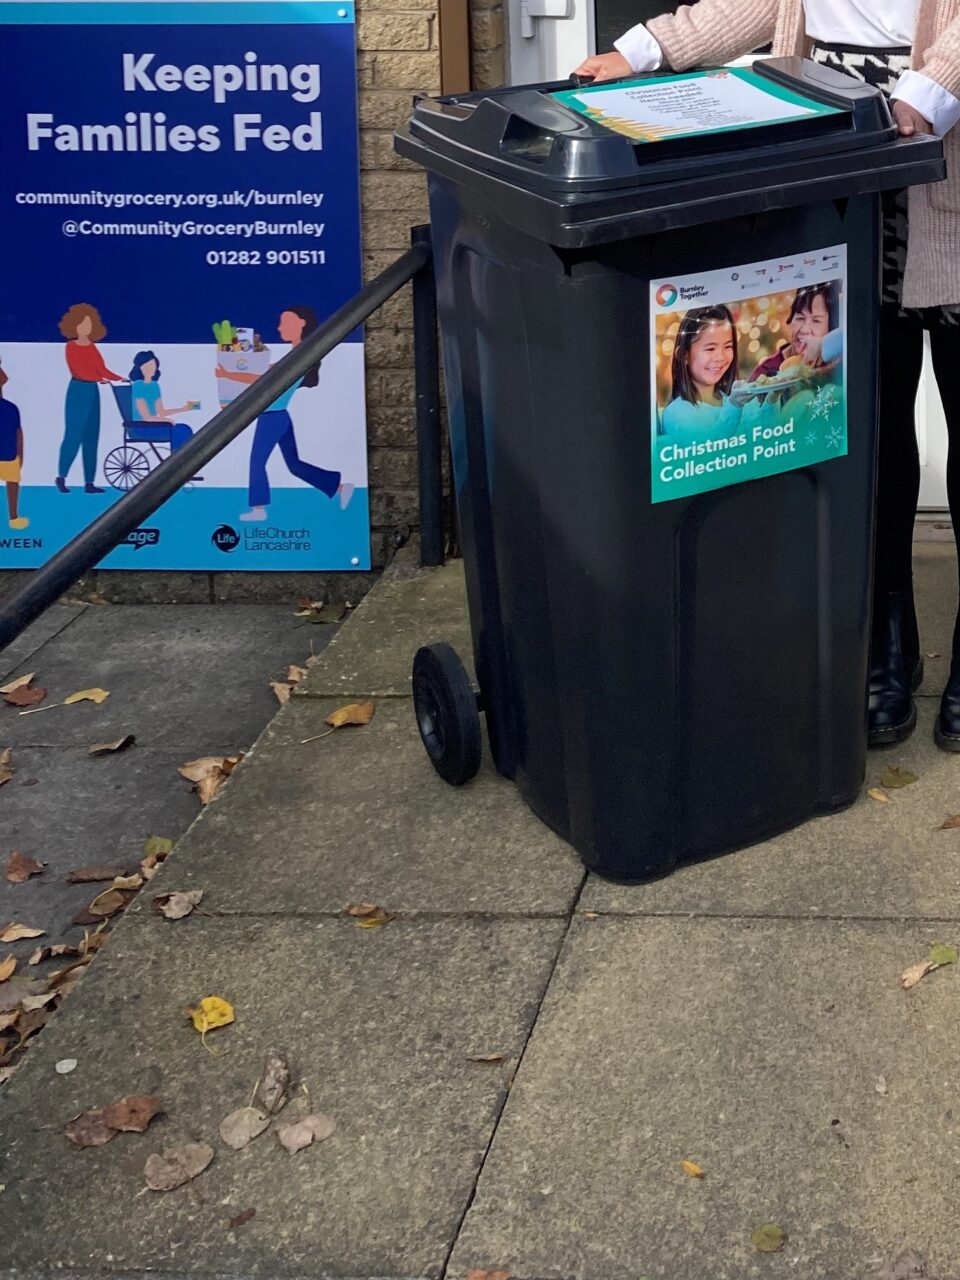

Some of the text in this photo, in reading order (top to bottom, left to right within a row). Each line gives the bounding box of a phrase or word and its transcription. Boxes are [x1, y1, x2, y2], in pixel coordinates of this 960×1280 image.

[122, 53, 320, 103] Keeping
[27, 113, 323, 151] Families Fed
[16, 189, 323, 208] communitygrocery.org.uk/burnley
[62, 221, 324, 238] @CommunityGroceryBurnley
[207, 250, 325, 265] 01282 901511
[680, 285, 704, 293] Burnley
[680, 291, 708, 300] Together
[660, 418, 794, 462] Christmas Food
[660, 439, 795, 482] Collection Point
[217, 534, 235, 543] Life
[244, 527, 310, 539] LifeChurch
[244, 539, 311, 551] Lancashire
